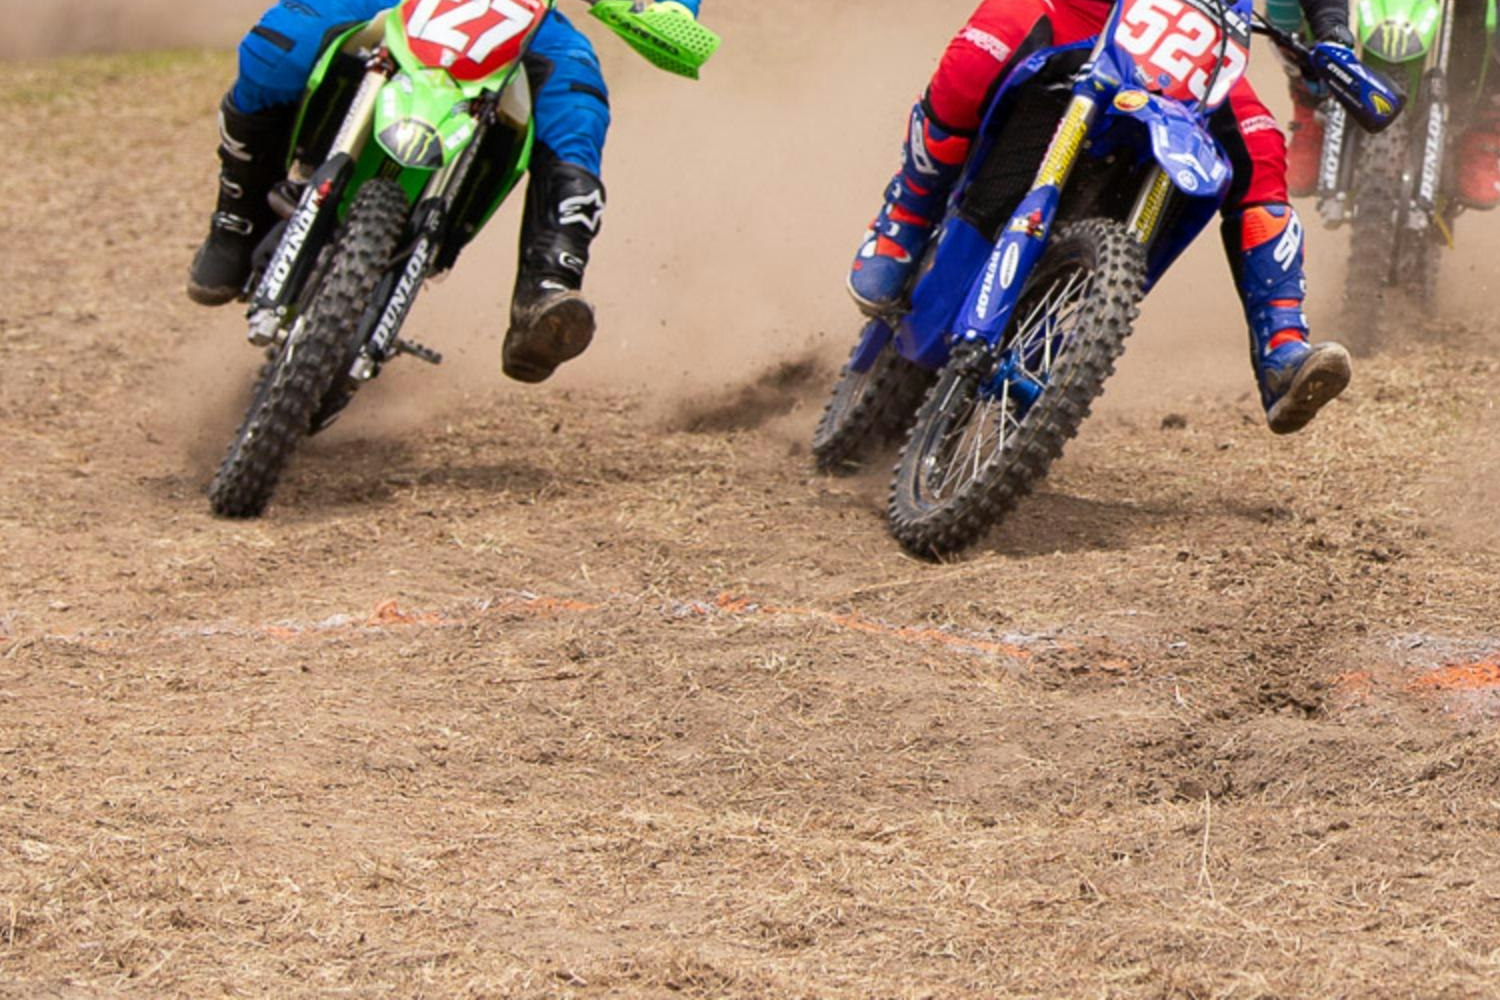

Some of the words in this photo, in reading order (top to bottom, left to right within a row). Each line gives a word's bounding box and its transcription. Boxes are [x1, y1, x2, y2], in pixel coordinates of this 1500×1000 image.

[1419, 103, 1444, 201] DUNLOP
[373, 237, 432, 352] DUNLOP
[976, 246, 1001, 319] DUNLOP
